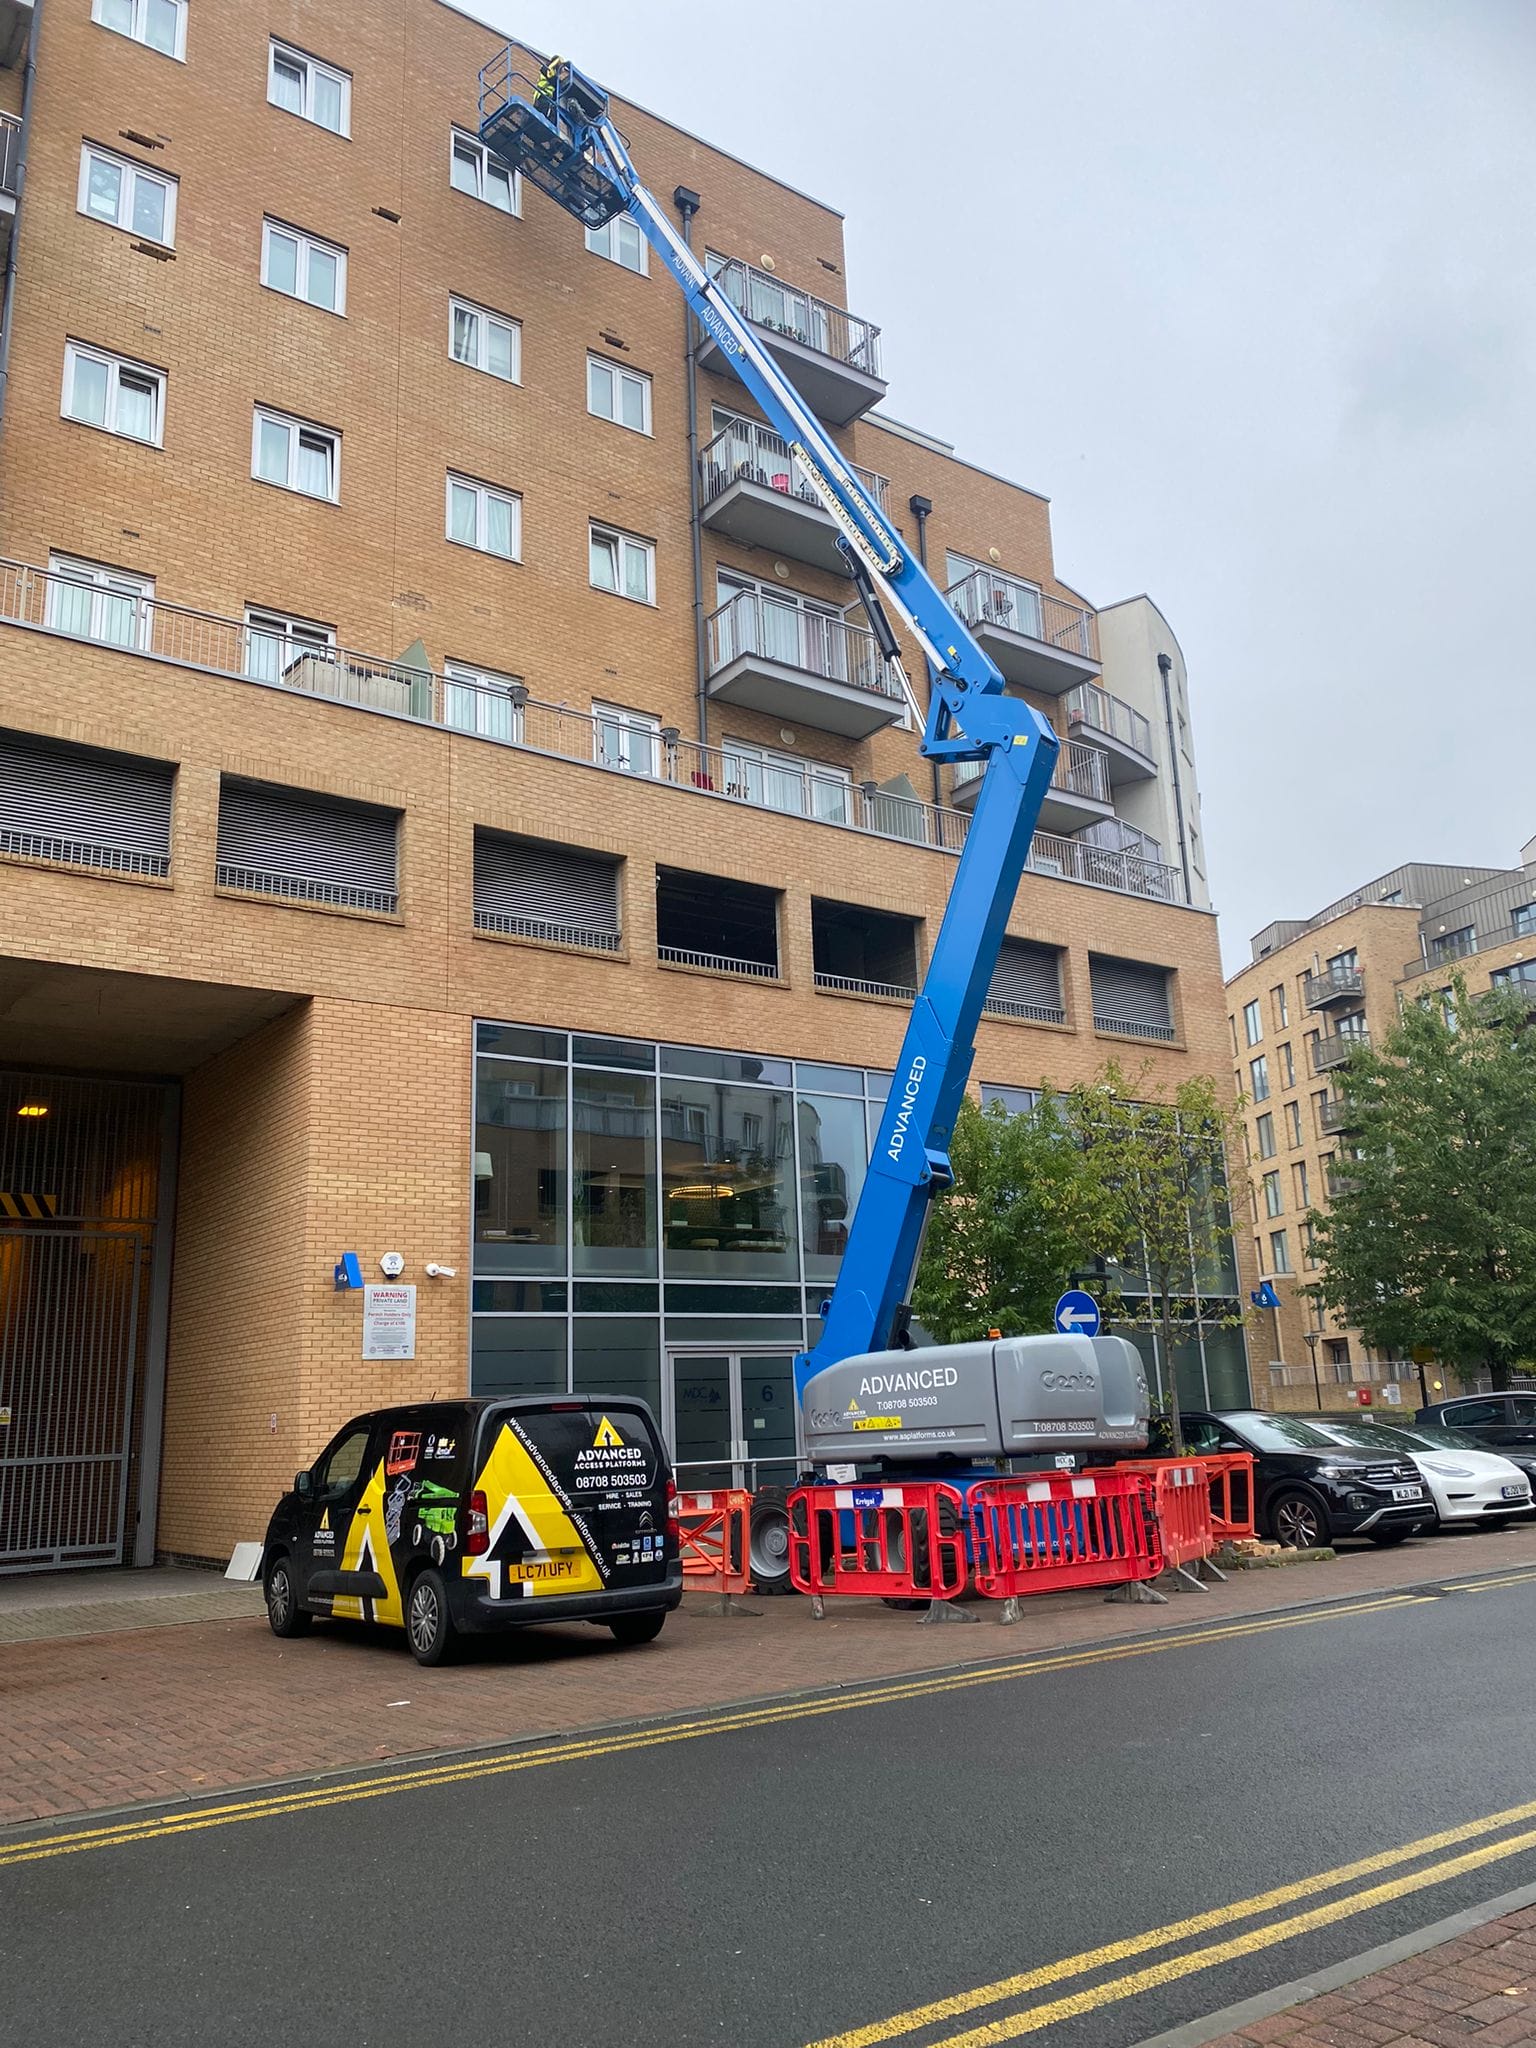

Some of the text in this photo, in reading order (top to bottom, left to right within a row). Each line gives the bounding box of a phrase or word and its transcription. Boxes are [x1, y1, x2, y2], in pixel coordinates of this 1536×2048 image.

[701, 305, 738, 355] ADVANCED
[887, 1055, 927, 1162] ADVANCED
[859, 1367, 958, 1396] ADVANCED
[1040, 1370, 1096, 1392] Genie
[762, 1385, 773, 1401] 6
[877, 1396, 938, 1411] T:08708 503503
[1068, 1421, 1095, 1431] 503503
[577, 1448, 642, 1462] ADVANCED
[574, 1460, 647, 1470] ACCESS PLATFORMS
[576, 1474, 647, 1488] 08708 503503
[606, 1492, 620, 1500] HIRE
[550, 1562, 573, 1576] UFY
